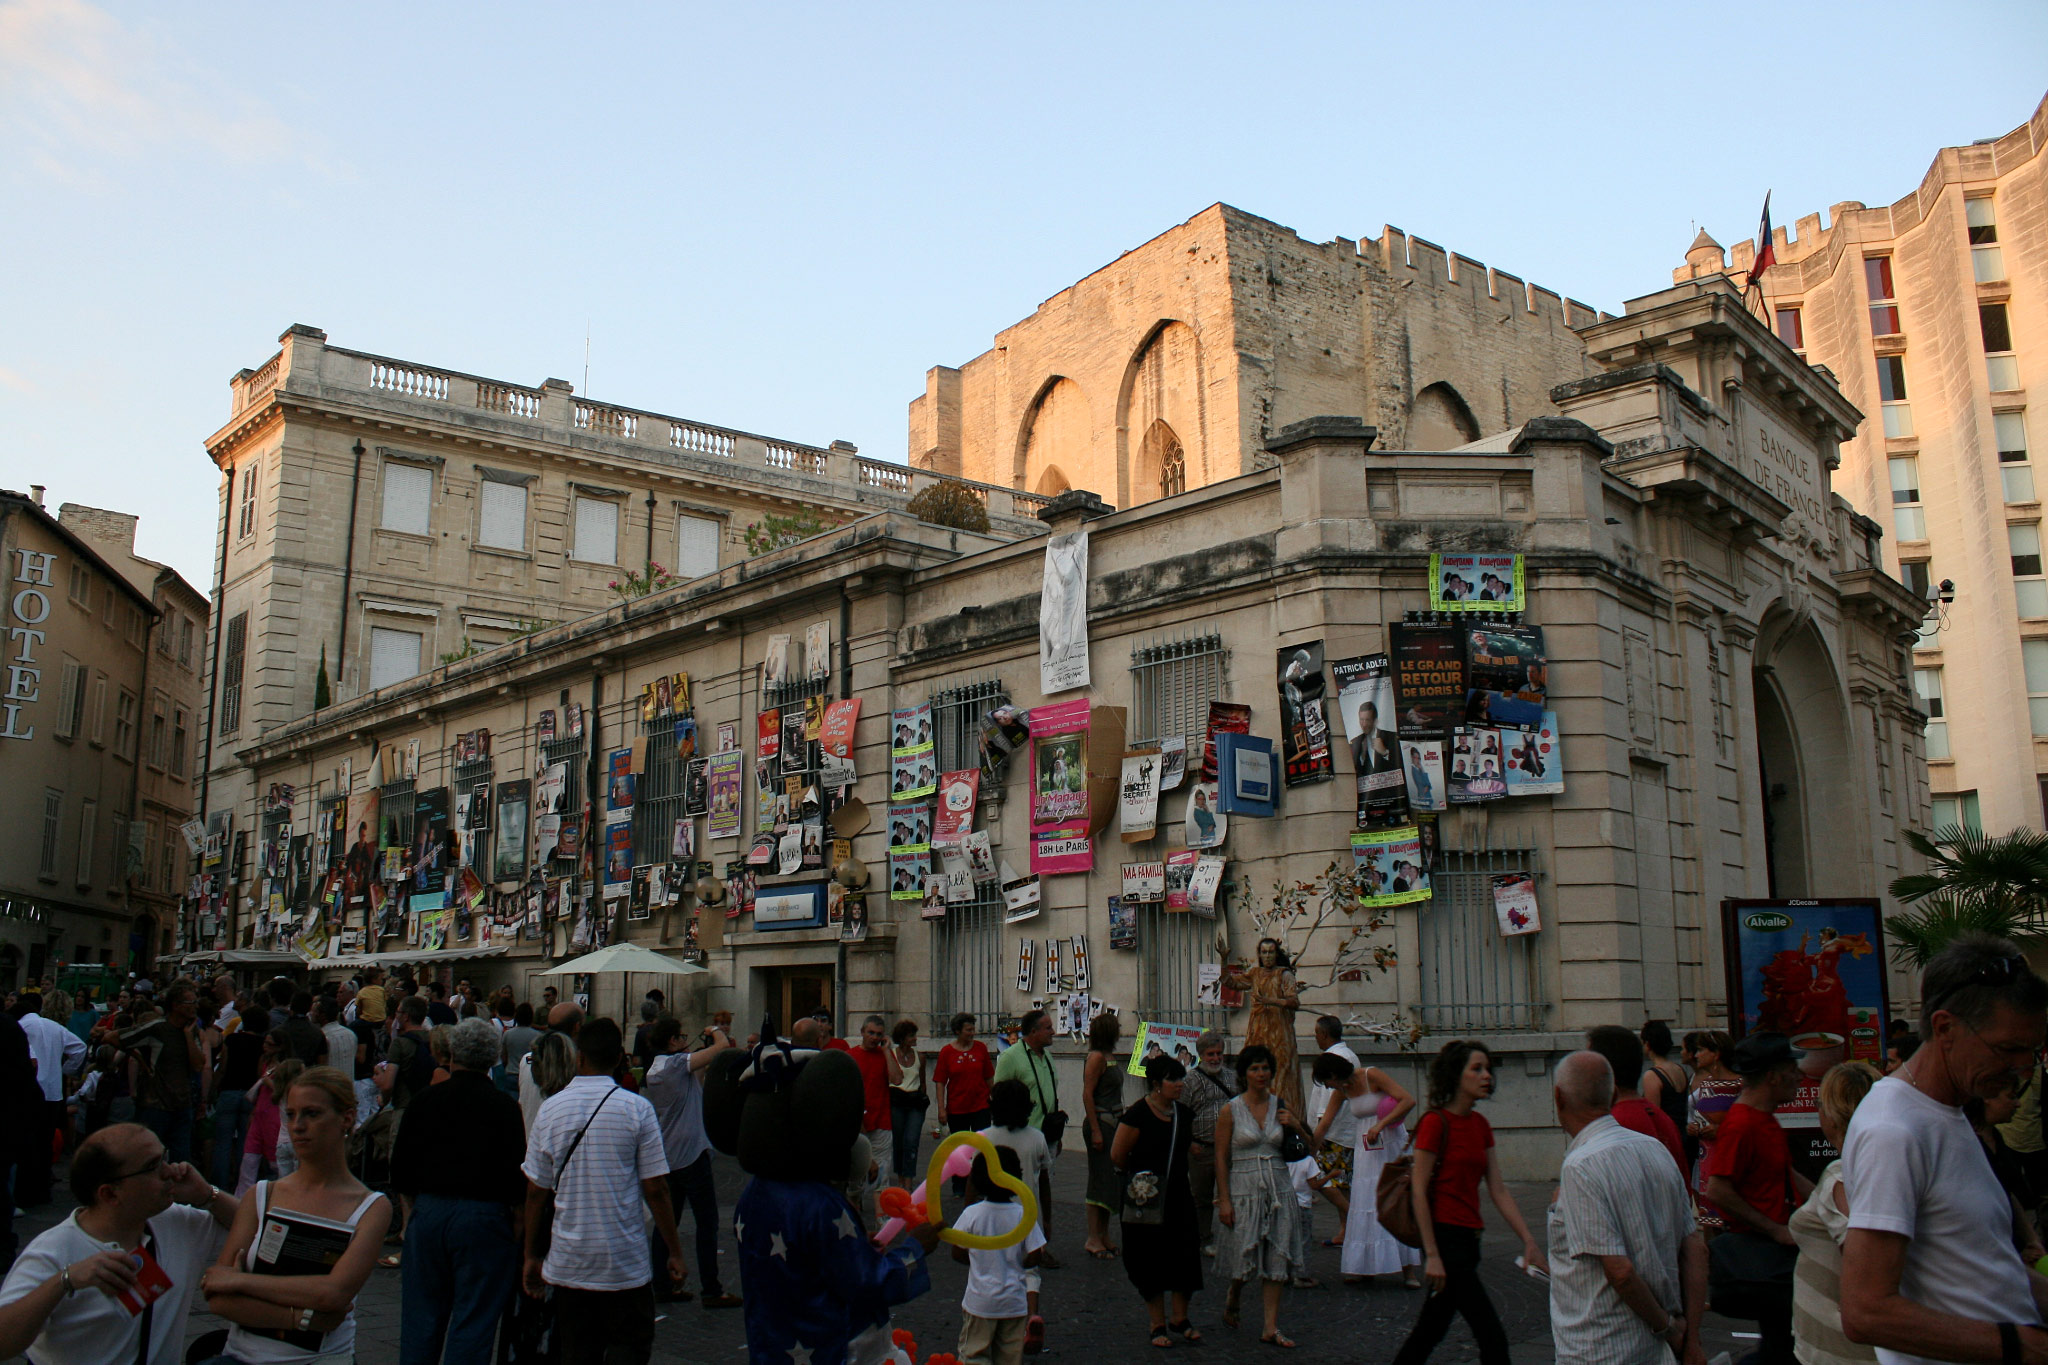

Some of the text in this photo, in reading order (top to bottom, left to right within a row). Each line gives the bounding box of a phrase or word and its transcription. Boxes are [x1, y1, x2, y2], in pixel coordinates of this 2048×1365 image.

[1760, 428, 1811, 485] BANQUE
[1754, 459, 1823, 527] DE FRANCE
[0, 548, 58, 741] HOTEL
[1334, 659, 1388, 675] PATRICK ADLER
[1401, 660, 1463, 671] LE GRAND
[1401, 672, 1463, 685] RETOUR
[1403, 684, 1465, 697] DE BORIS S.
[1047, 791, 1088, 804] Mariage
[1039, 841, 1089, 855] 18H Le PARIS
[1123, 864, 1163, 880] MA FAMILLE
[1750, 917, 1788, 927] Alvalle
[1822, 1148, 1839, 1157] dos
